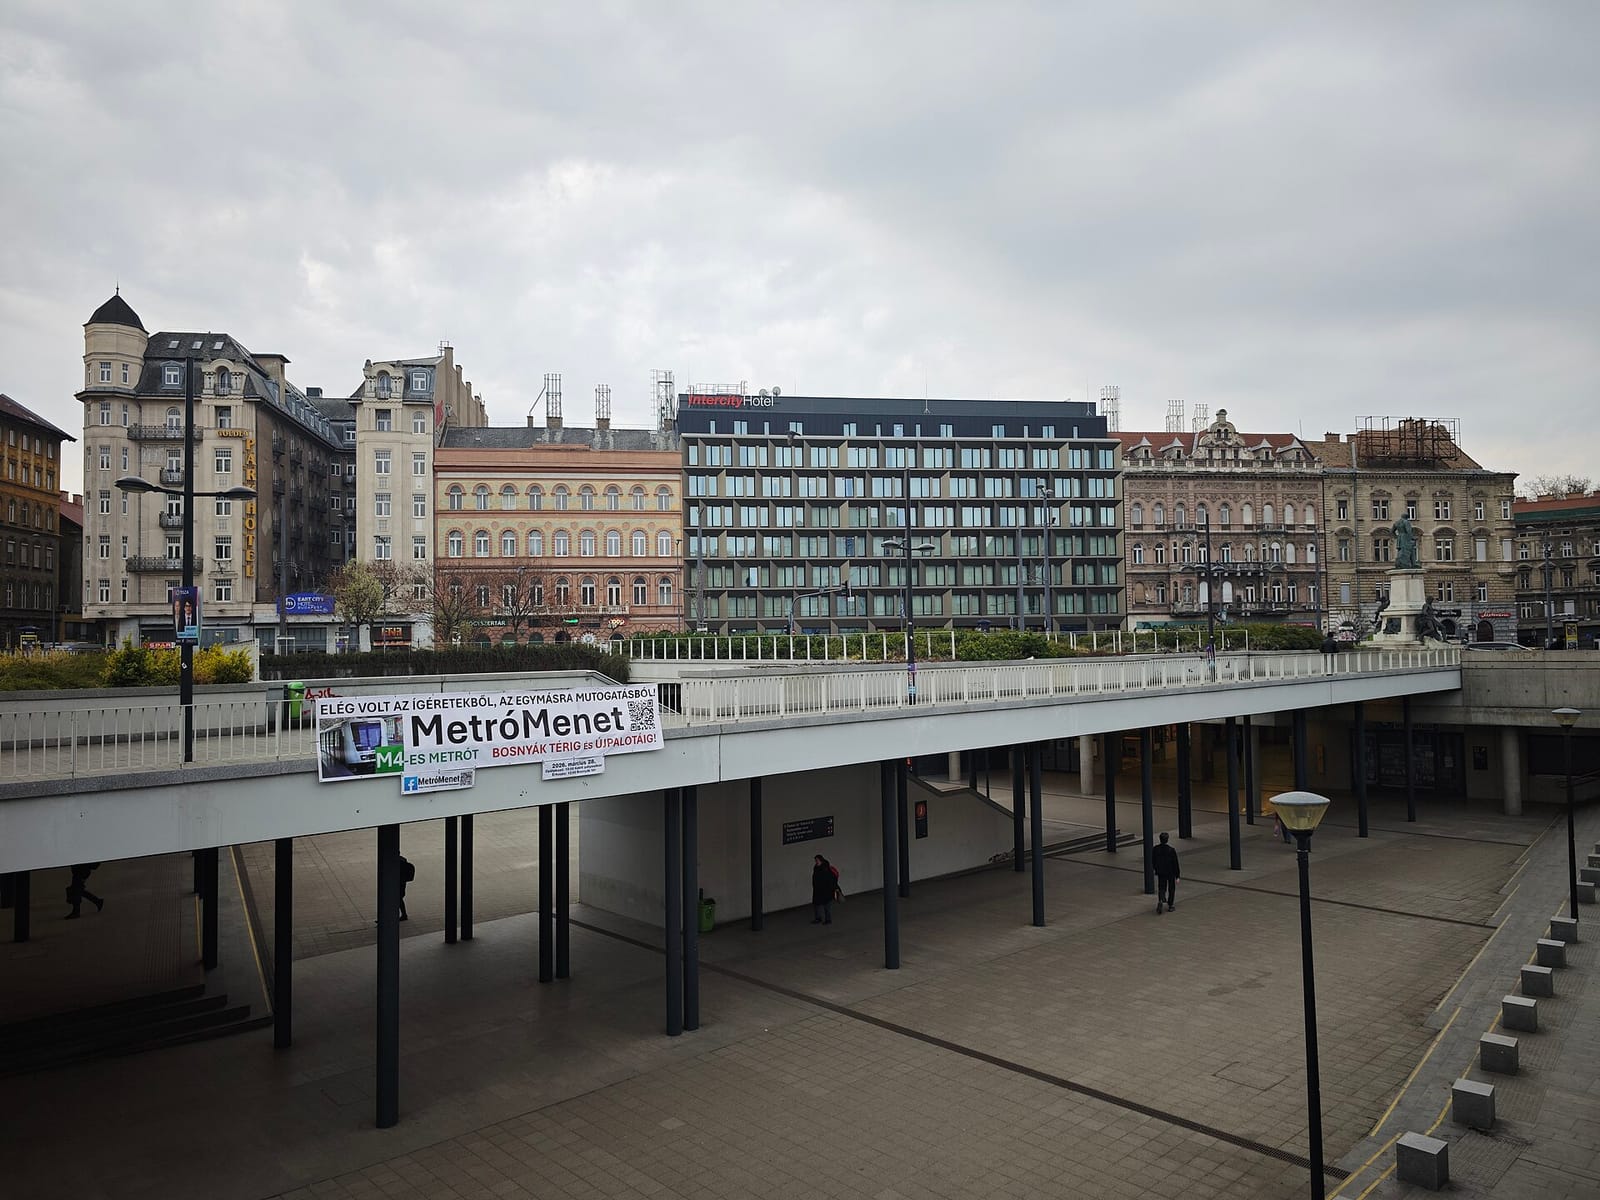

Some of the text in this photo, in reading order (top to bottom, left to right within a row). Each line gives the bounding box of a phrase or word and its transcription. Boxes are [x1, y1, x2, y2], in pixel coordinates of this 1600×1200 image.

[320, 687, 656, 715] ELÉG VOLT AZ ÍGÉRETEKBŐL, AZ EGYMÁSRA MUTOGATÁSBÓL!
[411, 706, 625, 747] MetróMenet
[492, 742, 547, 758] BOSNYÁK
[549, 740, 581, 753] TÉRIG
[595, 733, 657, 749] ÚJPALOTÁIG!
[376, 749, 480, 768] M4-ES METRÓT
[417, 775, 460, 786] MetróMenet
